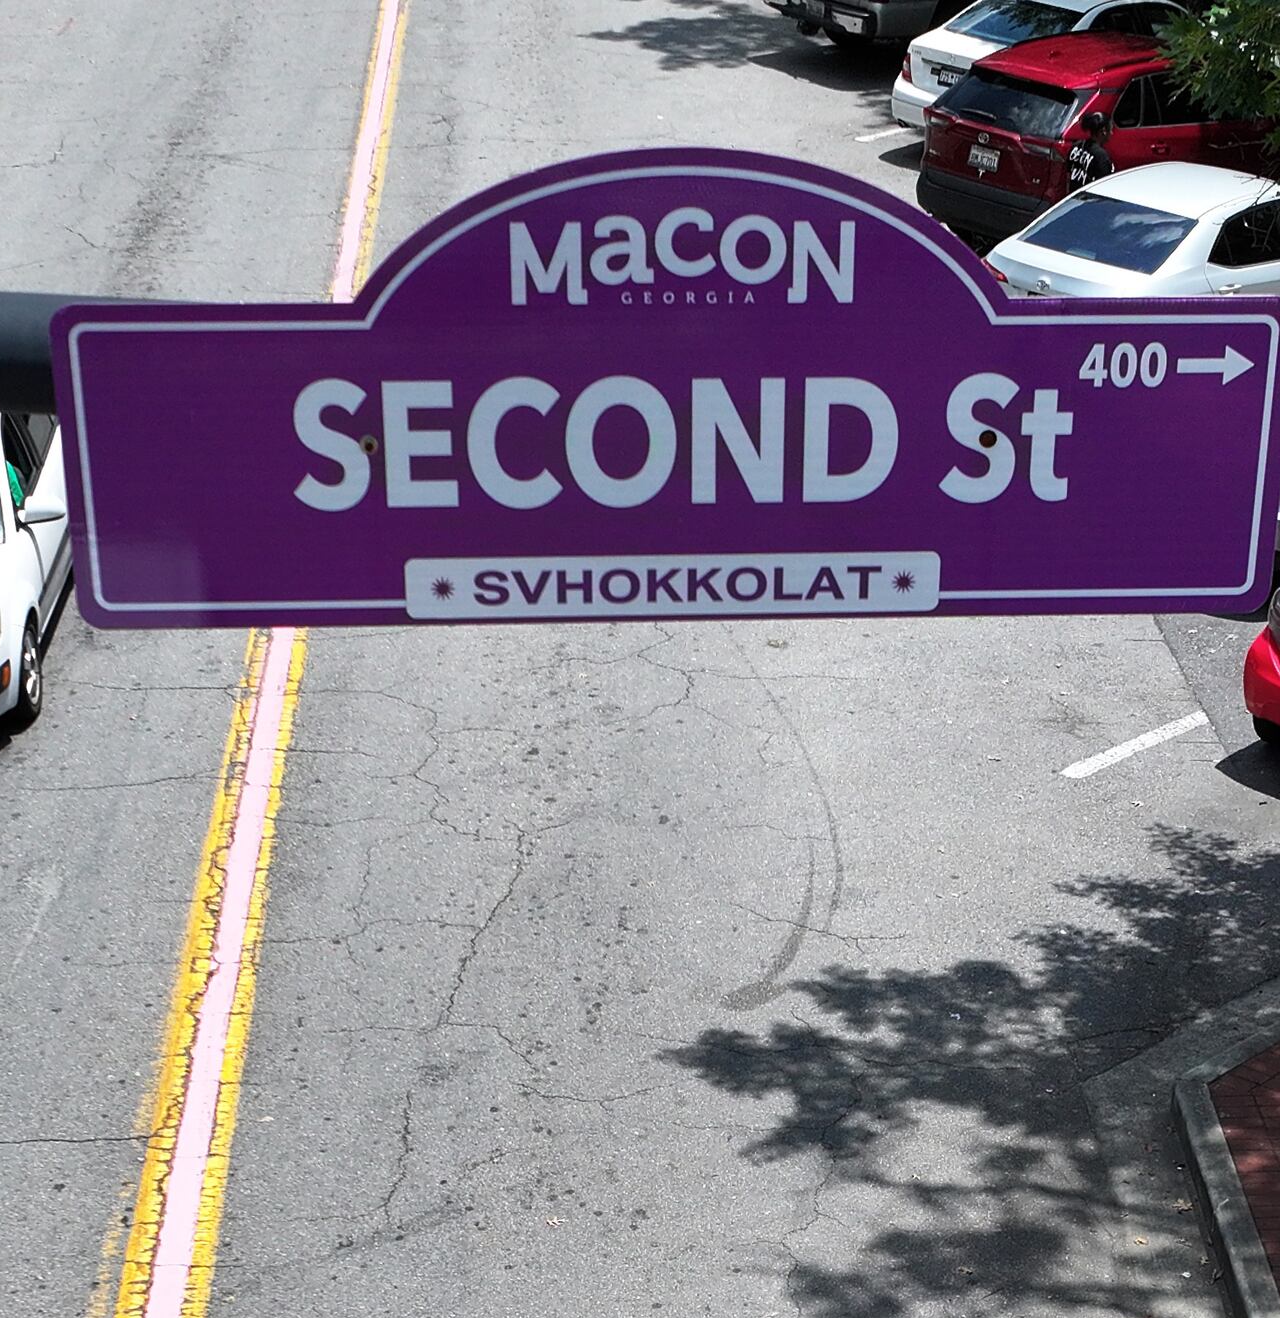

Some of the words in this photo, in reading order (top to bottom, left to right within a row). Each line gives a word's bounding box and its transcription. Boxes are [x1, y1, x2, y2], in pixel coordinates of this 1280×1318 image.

[620, 291, 755, 305] GEORGIA
[1078, 341, 1168, 389] 400
[293, 375, 899, 512] SECOND
[938, 371, 1074, 504] St
[473, 565, 883, 606] SVHOKKOLAT
